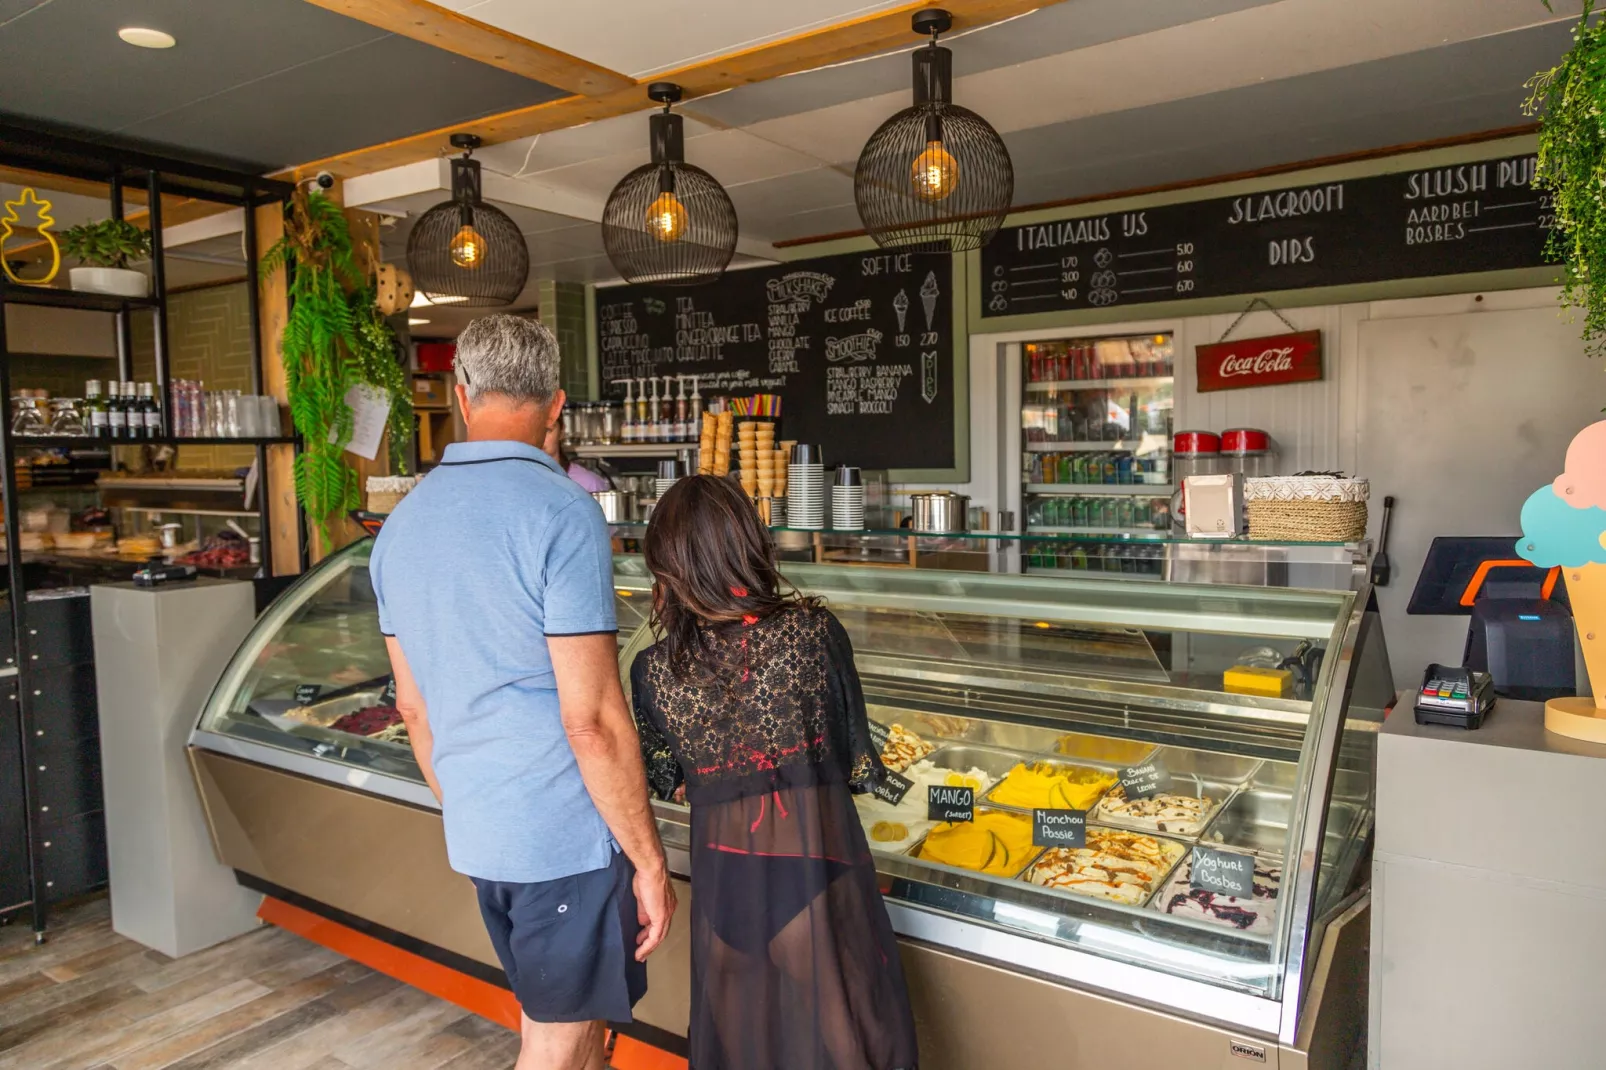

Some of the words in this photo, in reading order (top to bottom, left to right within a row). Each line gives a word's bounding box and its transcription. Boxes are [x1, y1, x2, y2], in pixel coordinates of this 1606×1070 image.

[1403, 164, 1487, 200] SLUSH
[1227, 184, 1343, 224] SLAGROOM
[1407, 200, 1479, 225] AARDBEI
[1017, 216, 1110, 252] ITALIAANS
[1406, 222, 1465, 246] BOSBES
[1269, 236, 1315, 266] DIPS
[861, 256, 891, 276] SOFT
[895, 252, 912, 273] ICE
[676, 297, 695, 313] TEA
[824, 308, 838, 323] ICE
[839, 307, 872, 322] COFFEE
[741, 323, 762, 343] TEA
[768, 325, 796, 338] MANGO
[825, 336, 877, 361] SMOOTHIES
[876, 364, 913, 378] BANANA
[1219, 347, 1294, 377] Coca-Cola
[827, 378, 857, 392] MANGO
[867, 389, 898, 402] MANGO
[929, 787, 972, 806] MANGO
[1036, 810, 1084, 825] Monchou
[1200, 869, 1242, 891] Bosbes
[1232, 1045, 1264, 1059] ORION
